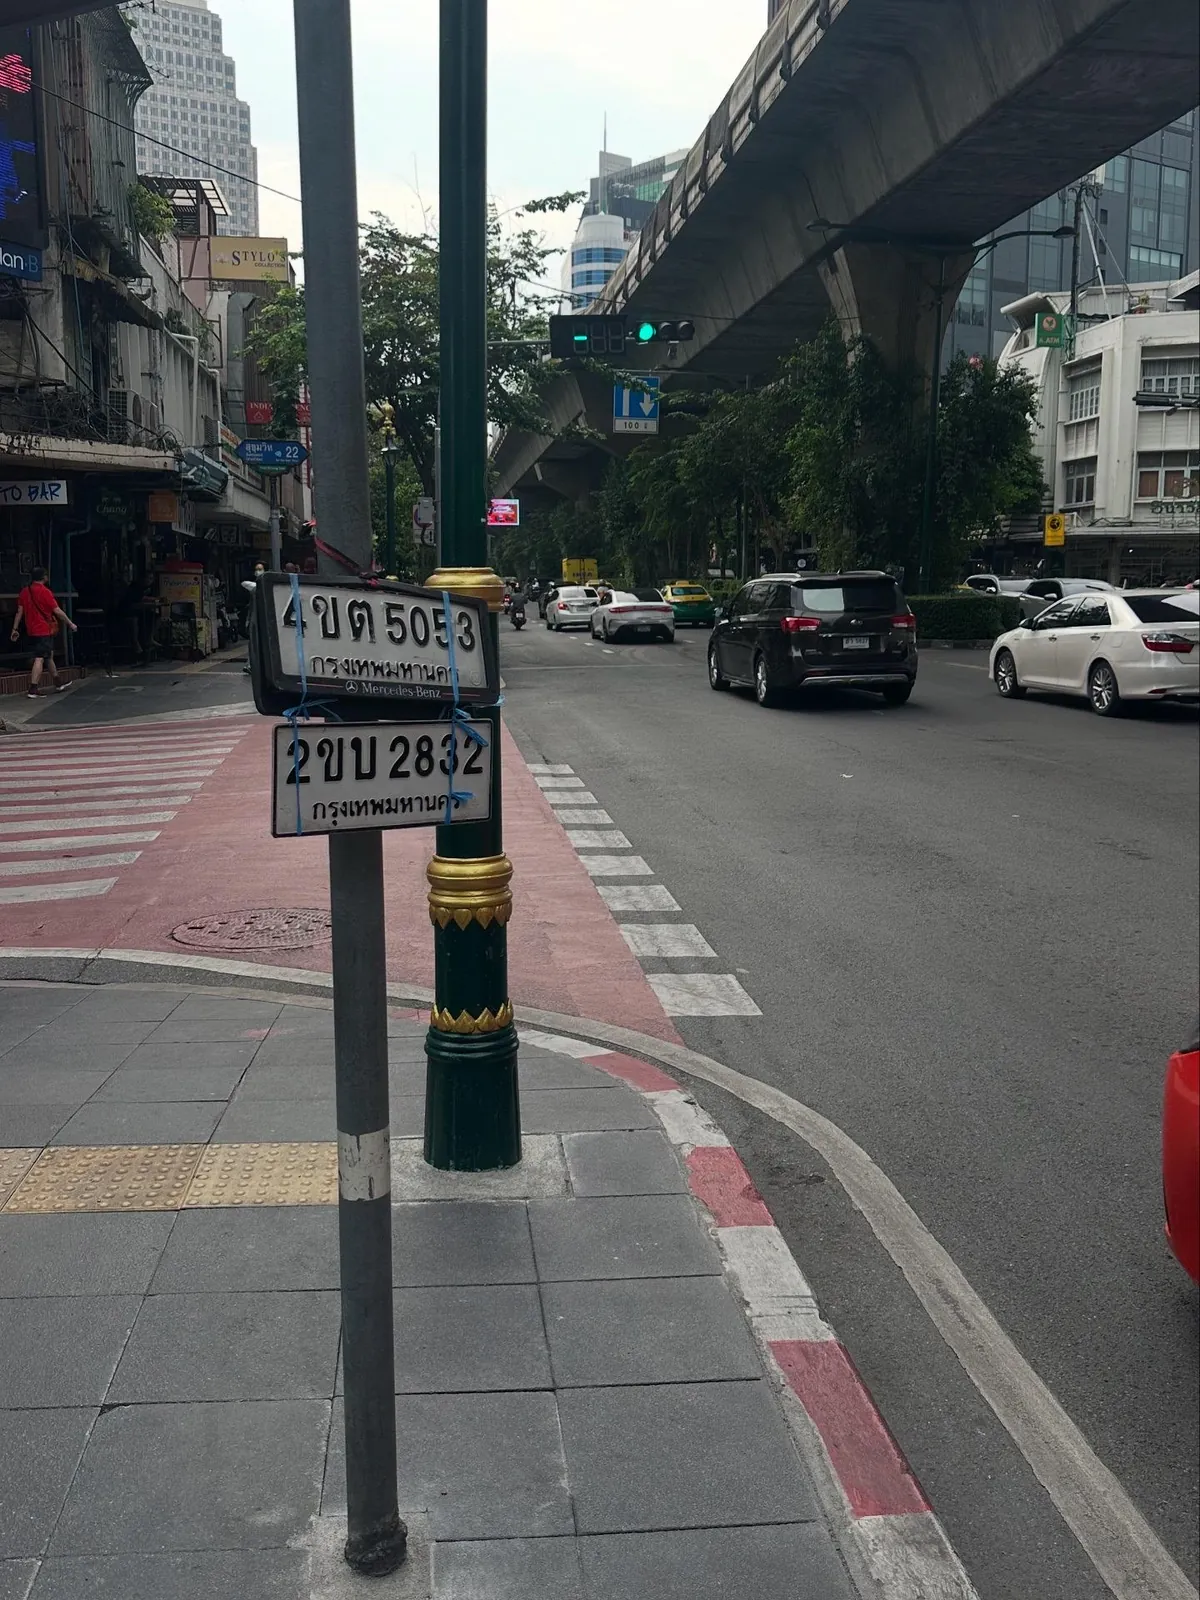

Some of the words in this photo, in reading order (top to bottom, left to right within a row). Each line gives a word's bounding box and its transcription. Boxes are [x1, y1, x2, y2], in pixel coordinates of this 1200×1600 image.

[624, 421, 639, 429] 100
[285, 446, 299, 458] 22
[28, 482, 61, 502] BAR
[281, 593, 375, 644] 4ขต
[383, 601, 476, 652] 5053
[362, 682, 441, 698] Mercedes-Benz
[285, 736, 376, 784] 2ขบ
[388, 734, 483, 778] 2832
